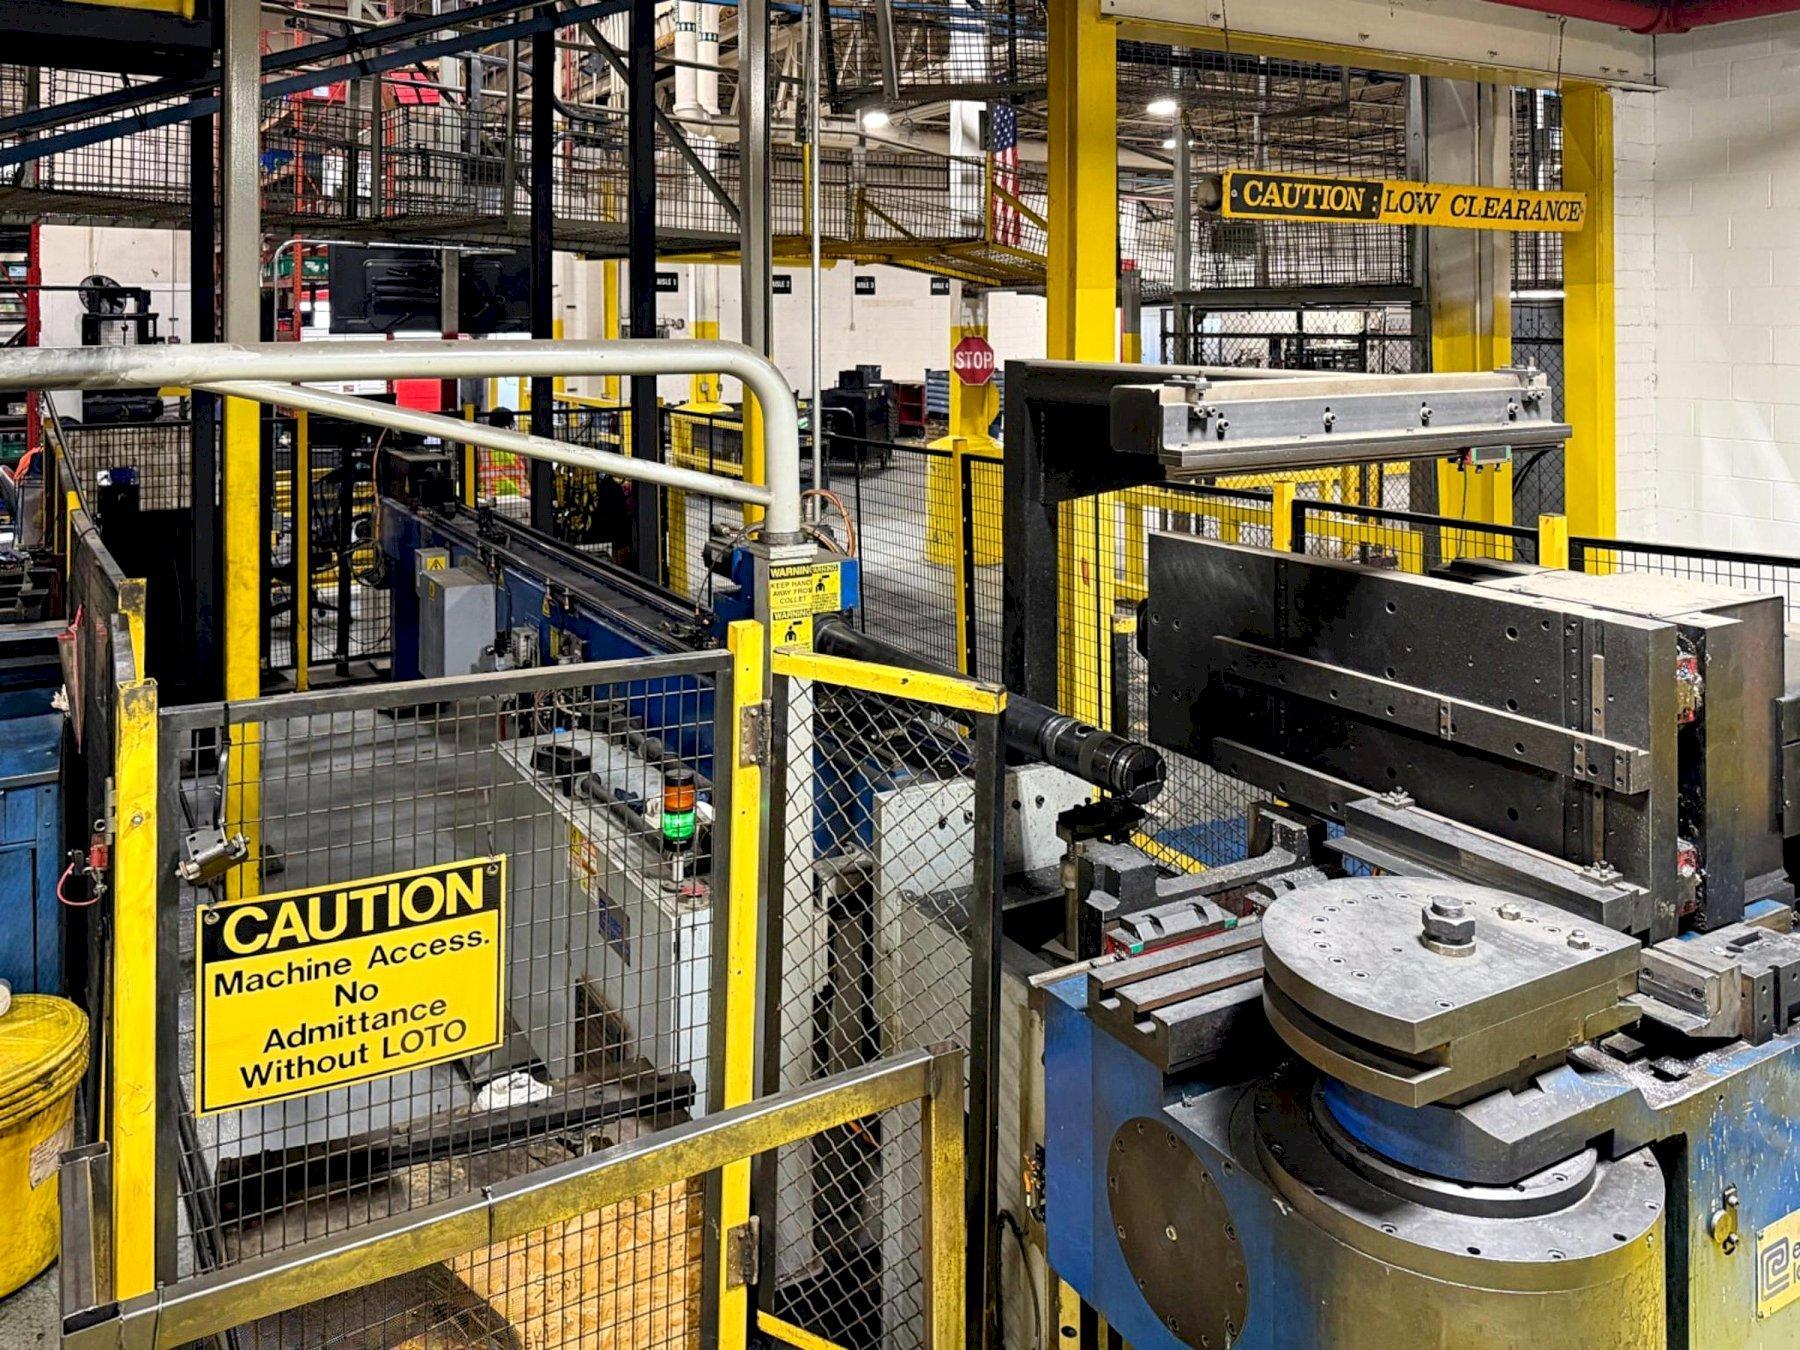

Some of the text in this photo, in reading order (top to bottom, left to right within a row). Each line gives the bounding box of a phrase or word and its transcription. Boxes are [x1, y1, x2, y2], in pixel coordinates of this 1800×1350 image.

[1384, 189, 1441, 215] LOW
[1450, 194, 1582, 222] CLEARANCE
[955, 351, 993, 369] STOP
[780, 595, 806, 604] COLLET
[791, 580, 812, 588] HAND
[223, 867, 483, 955] CAUTION
[214, 930, 490, 997] Machine Access.
[335, 983, 379, 1007] No
[263, 998, 447, 1053] Admittance
[240, 1018, 467, 1089] Without LOTO
